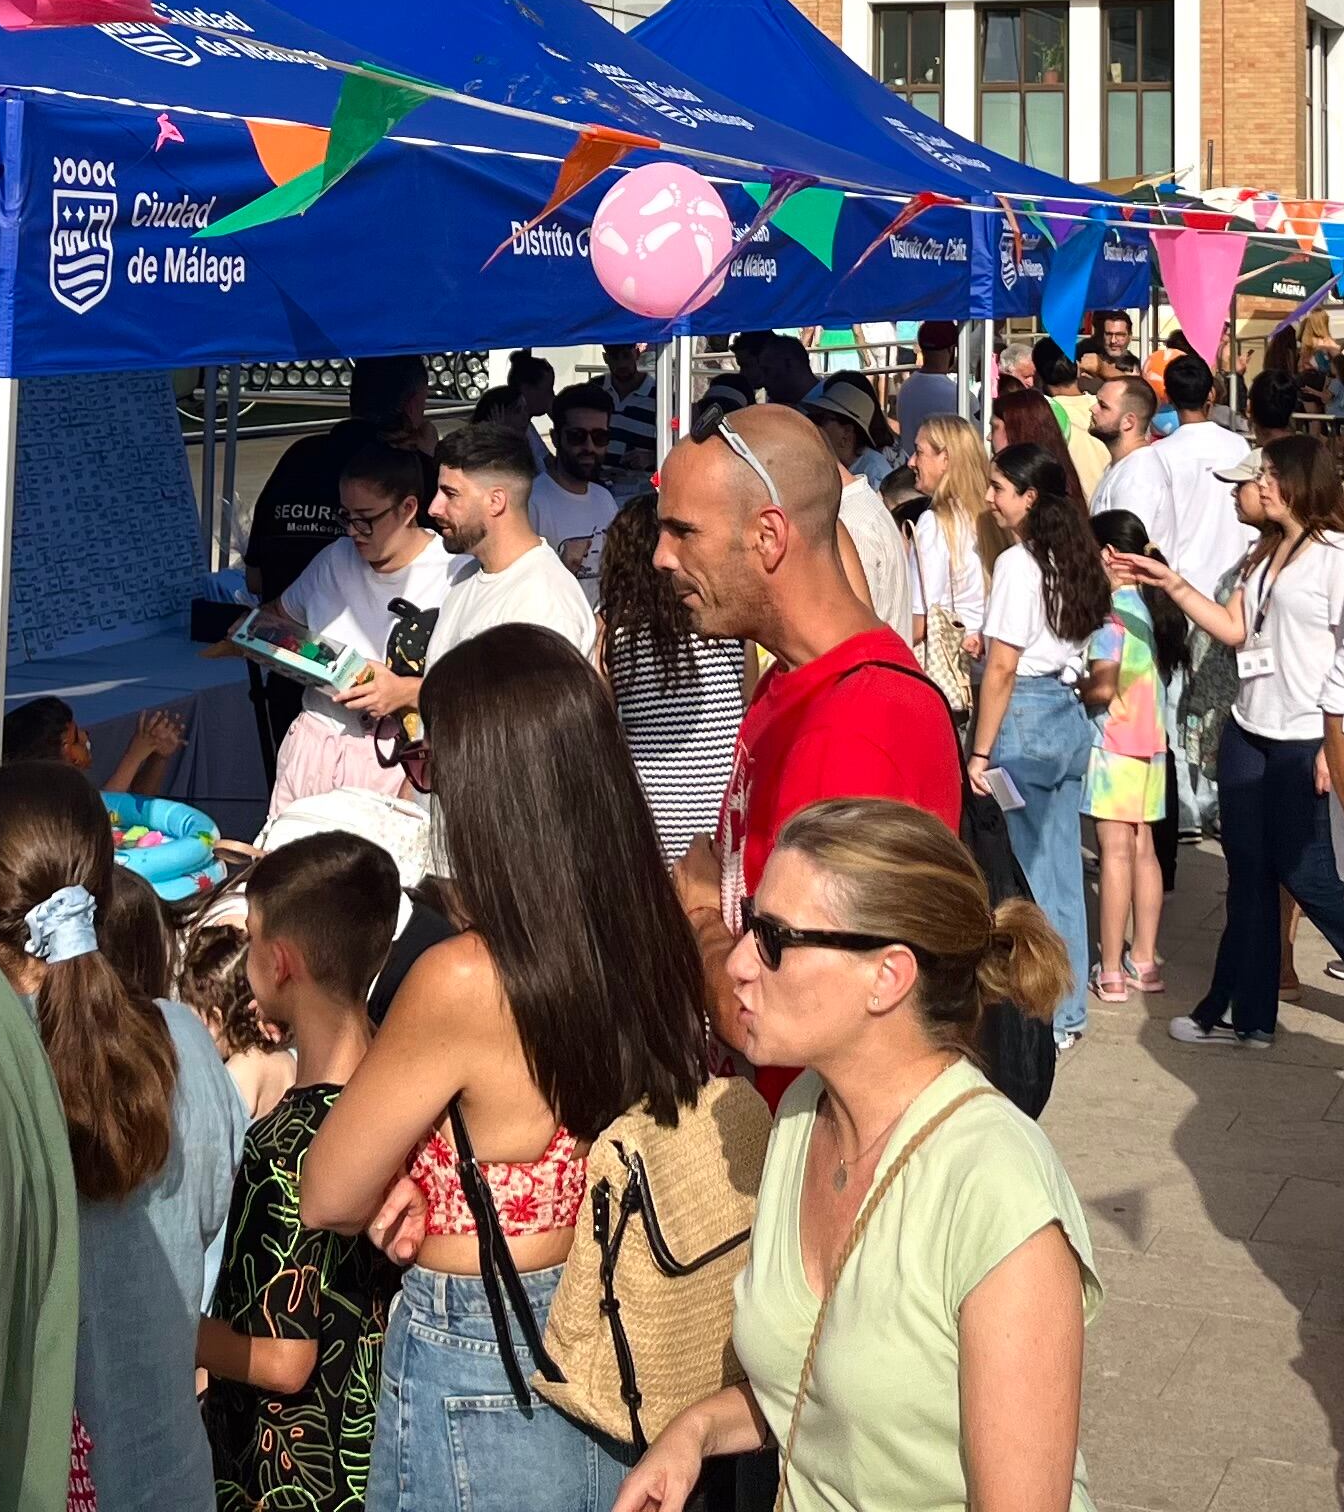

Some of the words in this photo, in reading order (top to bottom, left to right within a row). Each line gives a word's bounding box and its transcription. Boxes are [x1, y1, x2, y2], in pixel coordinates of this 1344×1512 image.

[195, 35, 242, 58] de
[131, 191, 217, 229] Ciudad
[510, 220, 574, 258] Distrito
[127, 246, 158, 284] de
[164, 245, 245, 293] Málaga
[743, 255, 778, 284] Málaga
[1272, 282, 1307, 297] MAGNA
